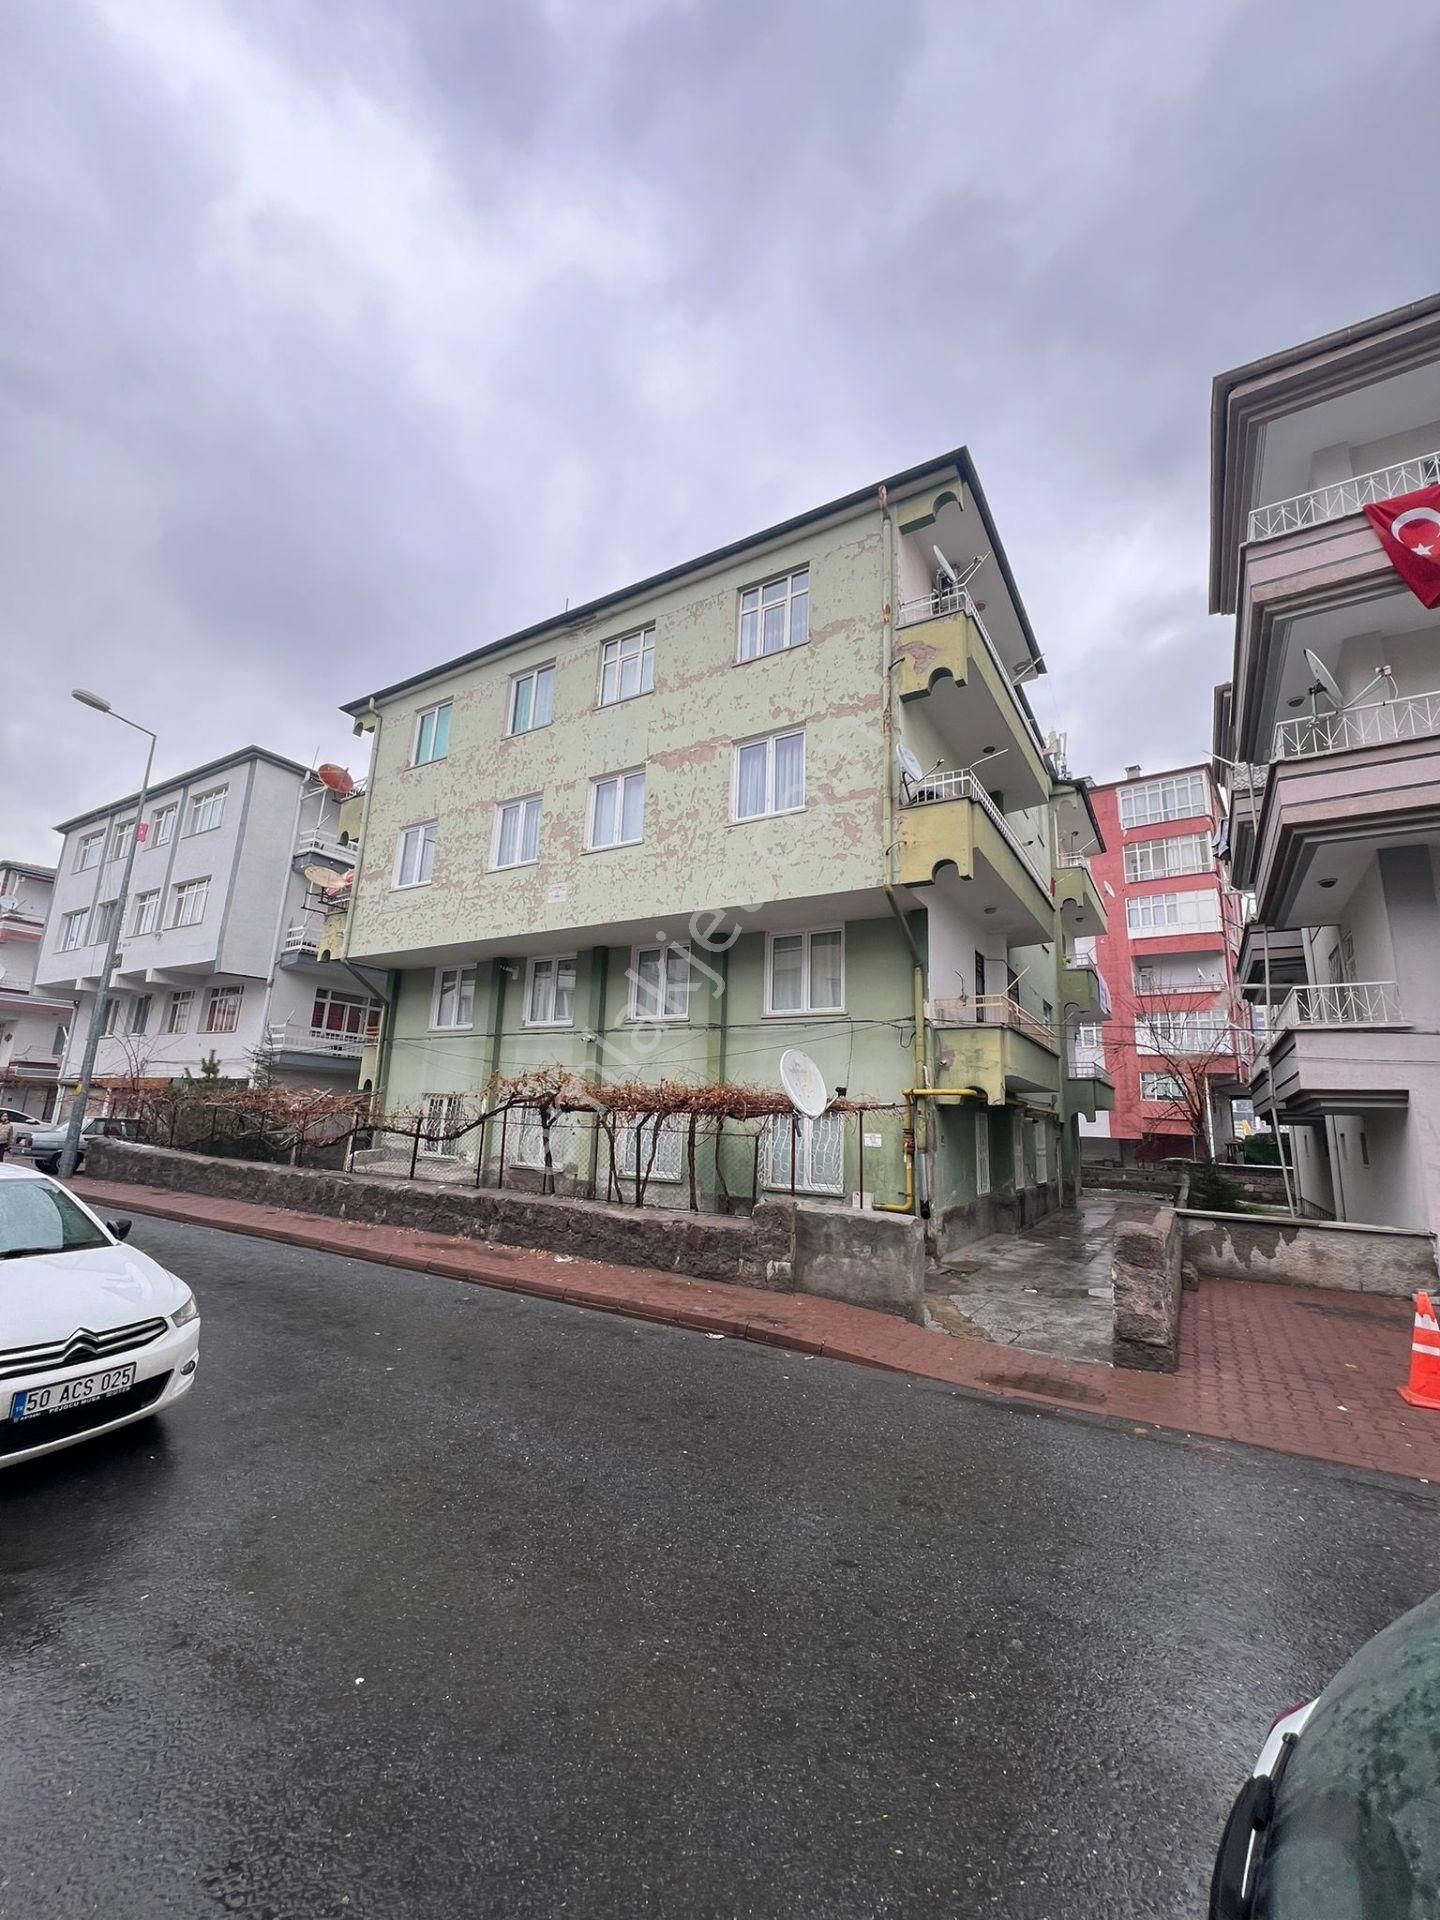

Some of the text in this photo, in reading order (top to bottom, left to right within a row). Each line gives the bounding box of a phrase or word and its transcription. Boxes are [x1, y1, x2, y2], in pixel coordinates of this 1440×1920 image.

[27, 1390, 51, 1412] 50
[59, 1378, 94, 1403] ACS
[101, 1367, 132, 1391] 025
